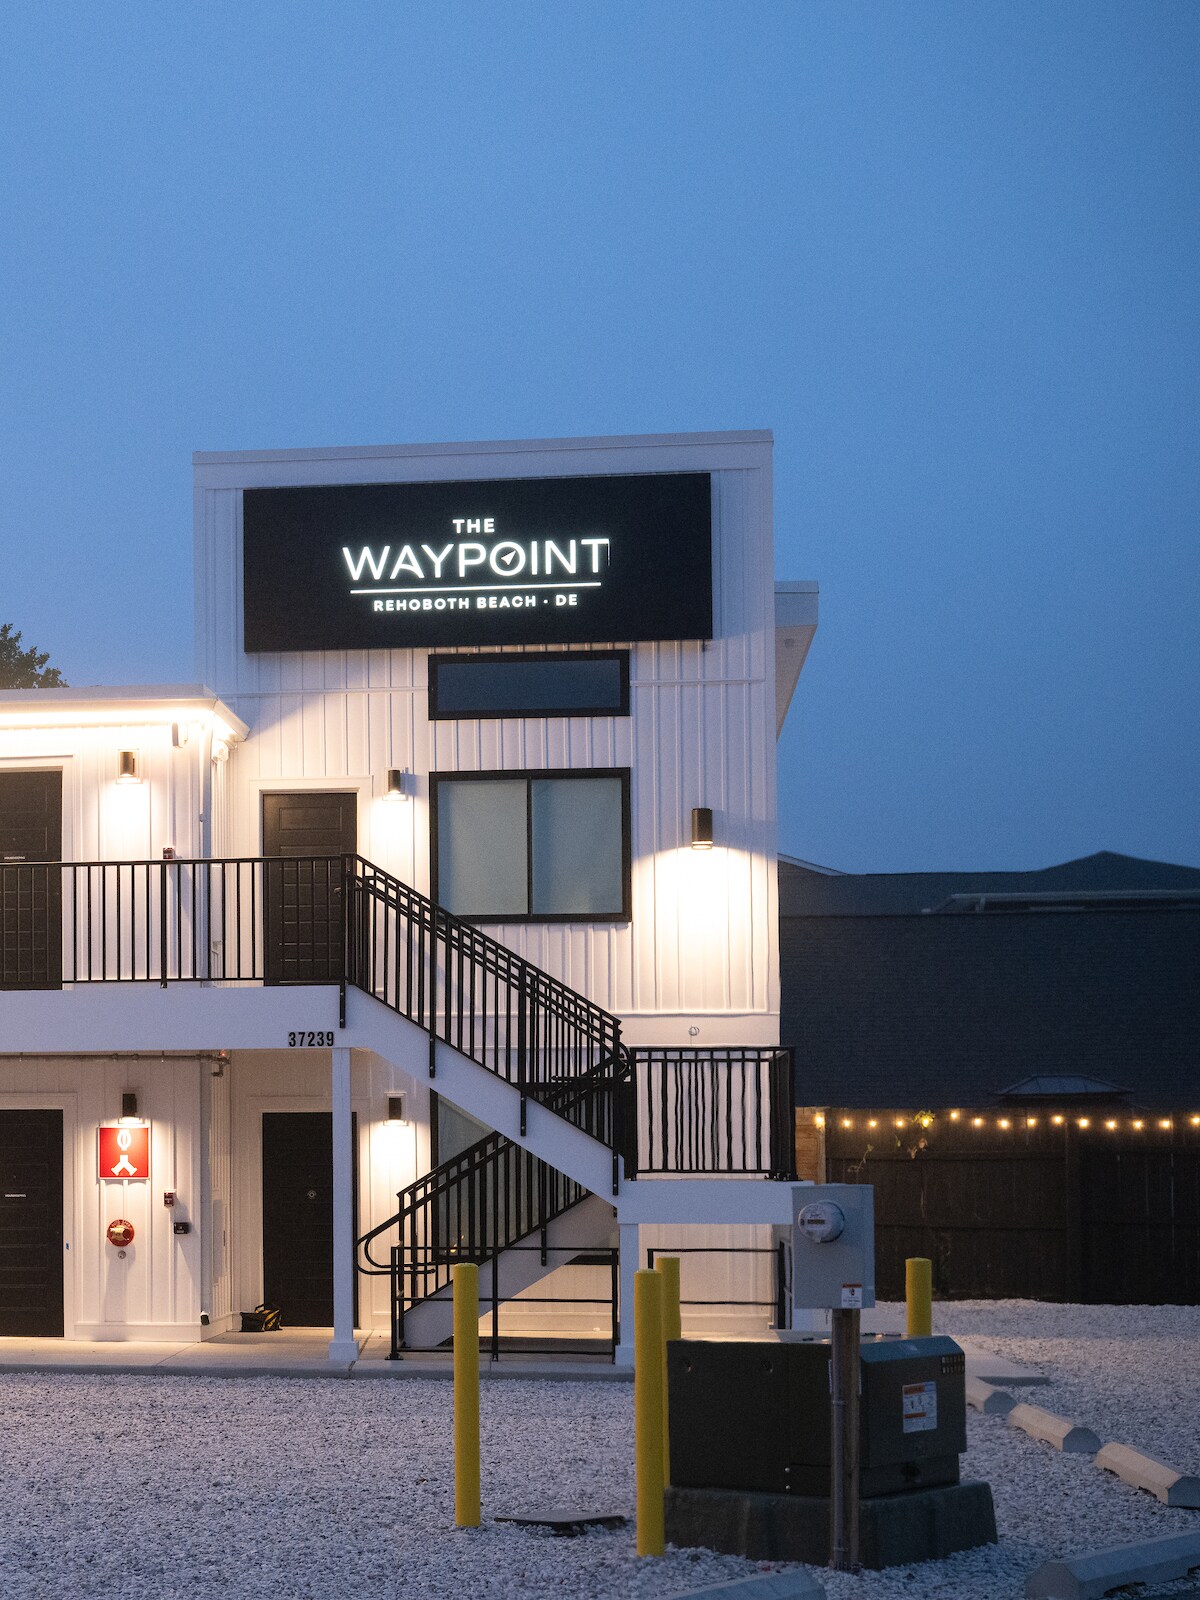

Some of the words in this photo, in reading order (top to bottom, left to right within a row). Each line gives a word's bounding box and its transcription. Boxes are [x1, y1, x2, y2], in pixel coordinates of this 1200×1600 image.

[452, 518, 495, 534] THE
[342, 538, 609, 581] WAYPOINT
[373, 598, 470, 612] REHOBOTH
[476, 595, 536, 609] BEACH
[555, 594, 578, 606] DE
[288, 1031, 334, 1047] 37239
